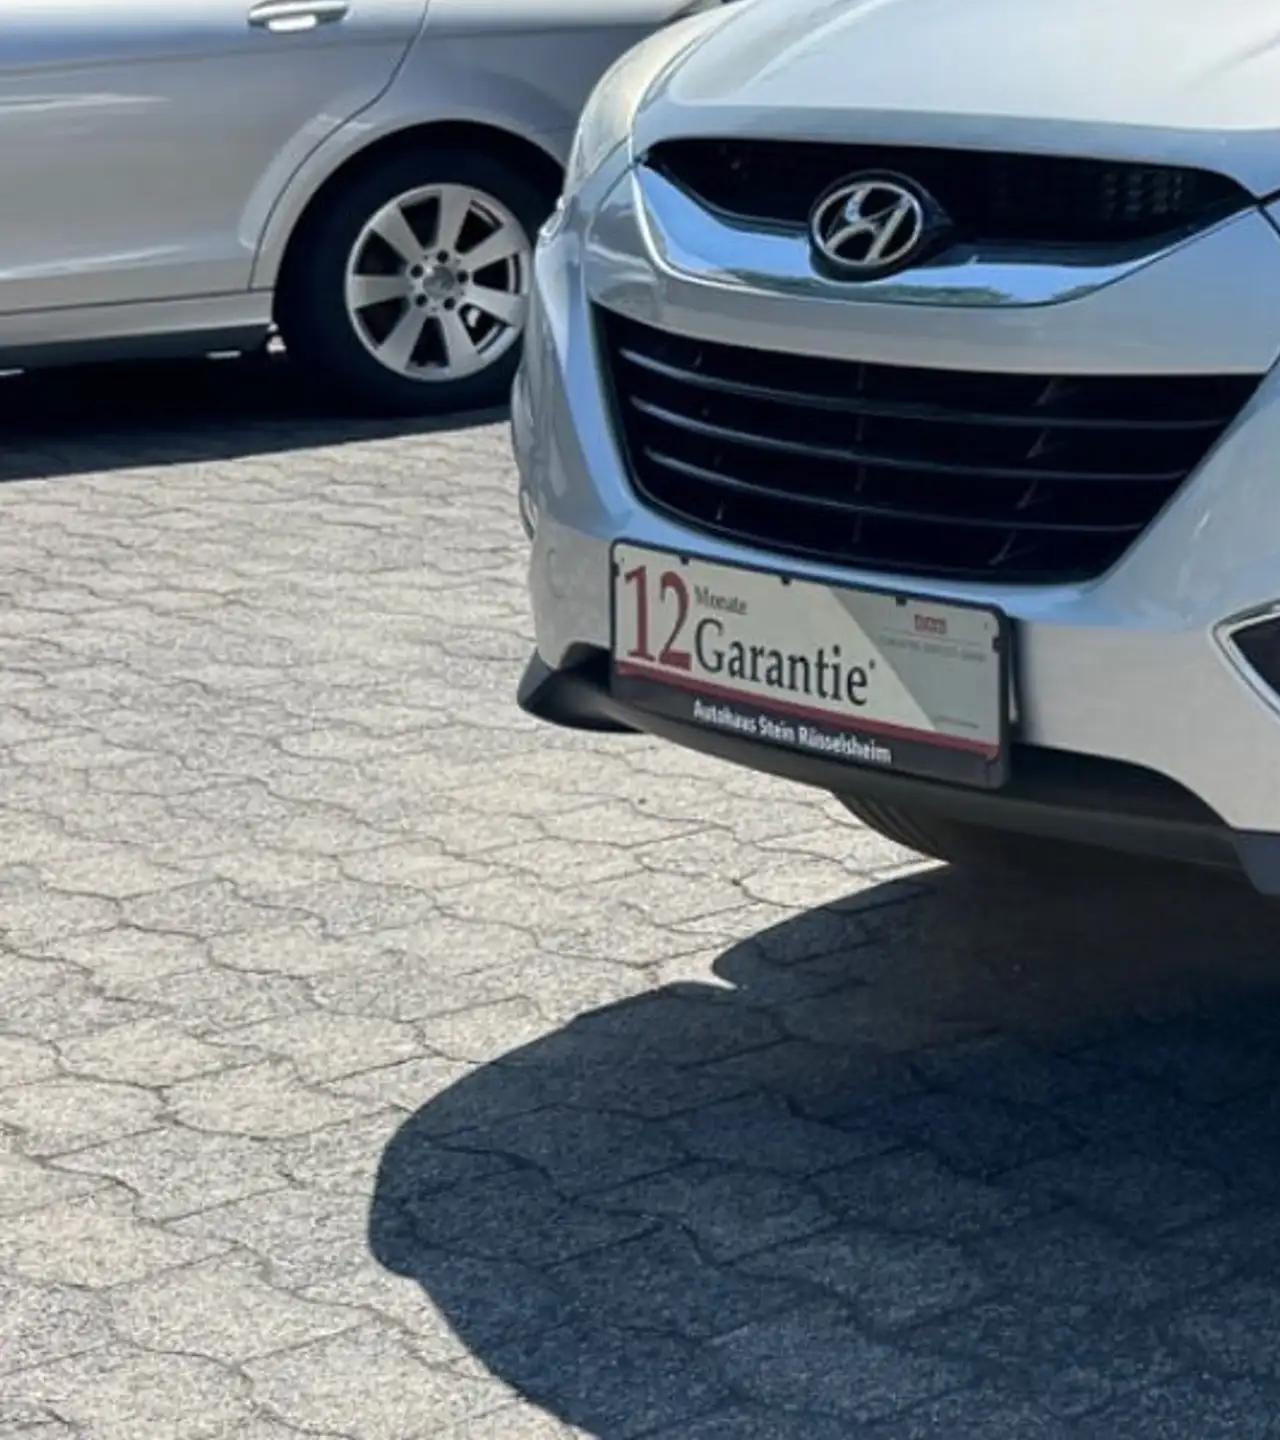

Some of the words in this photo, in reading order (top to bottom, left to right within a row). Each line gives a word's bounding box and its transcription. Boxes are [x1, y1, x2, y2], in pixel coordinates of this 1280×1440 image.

[623, 564, 692, 671] 12
[693, 583, 748, 616] Monate
[693, 698, 758, 735] Autohaus
[758, 714, 796, 746] Stein
[797, 724, 893, 765] Rüsselsheim
